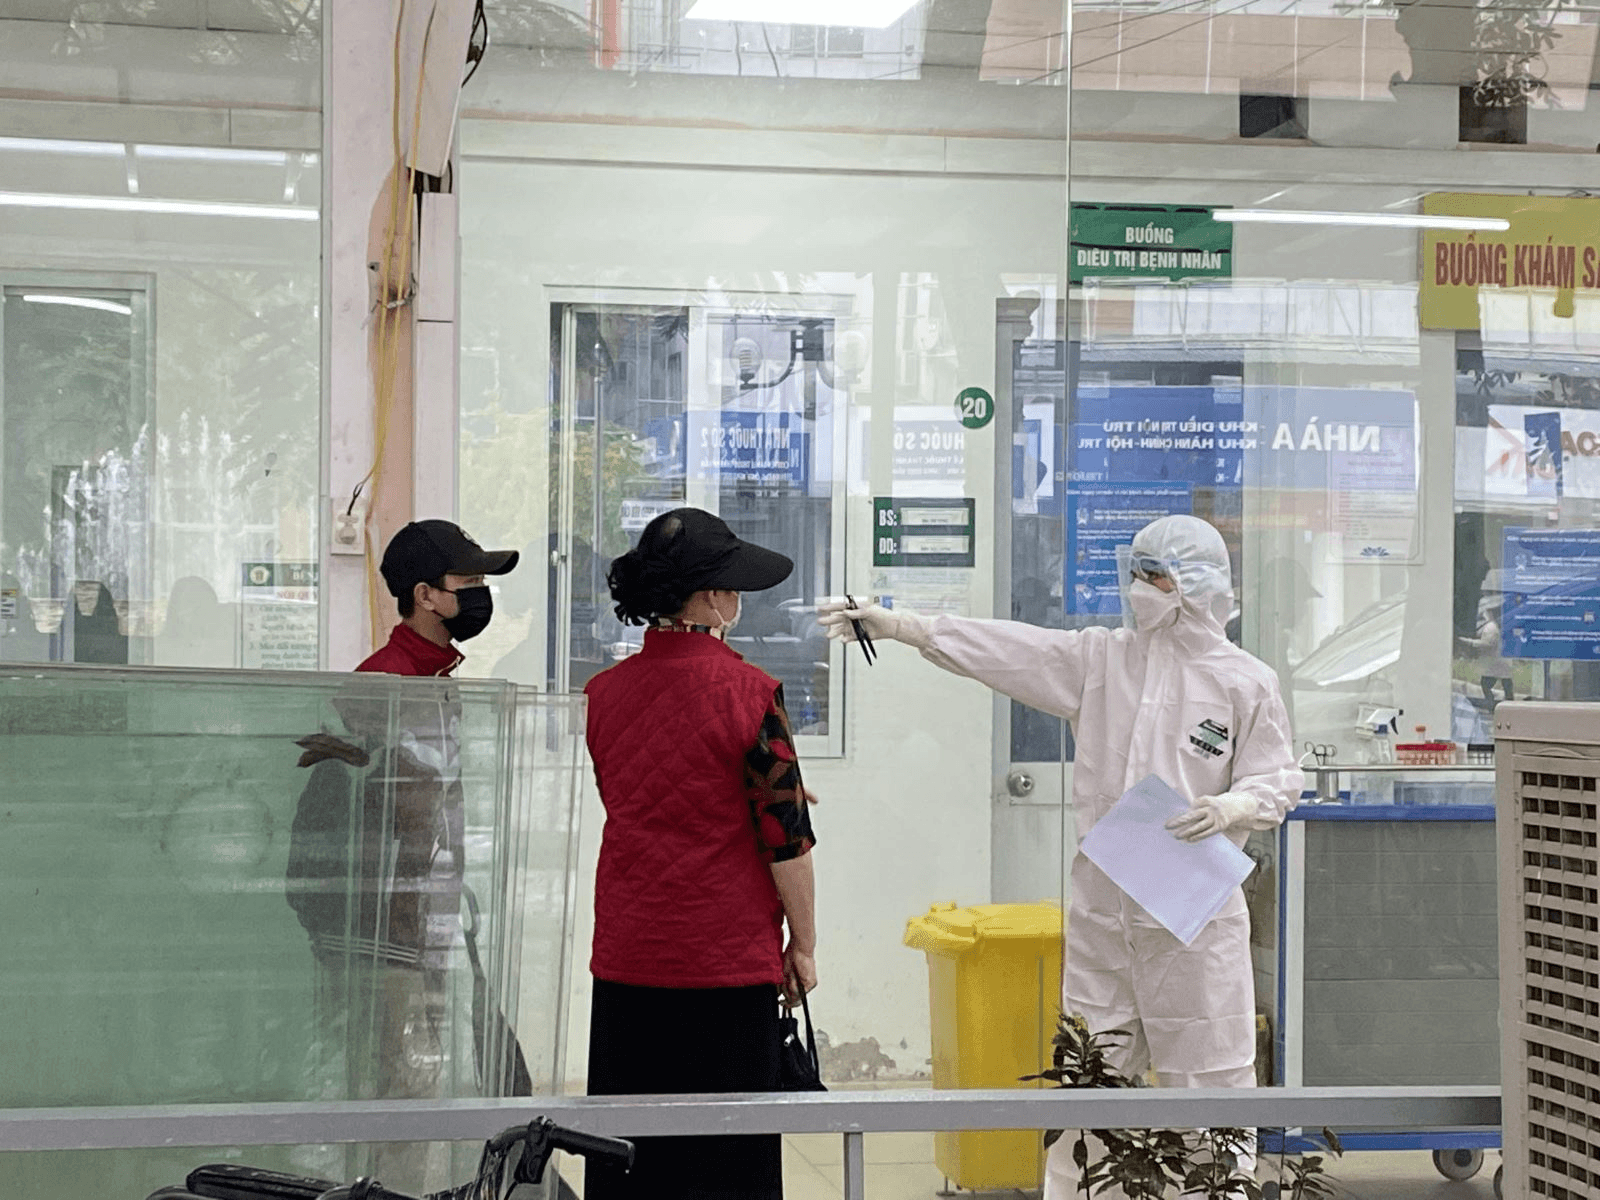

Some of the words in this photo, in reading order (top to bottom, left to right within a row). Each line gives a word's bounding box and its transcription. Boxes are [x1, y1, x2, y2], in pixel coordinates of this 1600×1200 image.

[1113, 250, 1136, 271] TRỊ
[1139, 251, 1178, 271] BỆNH
[1181, 250, 1222, 269] NHÂN
[1514, 235, 1576, 289] KHÁM
[1581, 246, 1600, 289] S
[962, 396, 987, 418] 20
[879, 509, 898, 526] BS:
